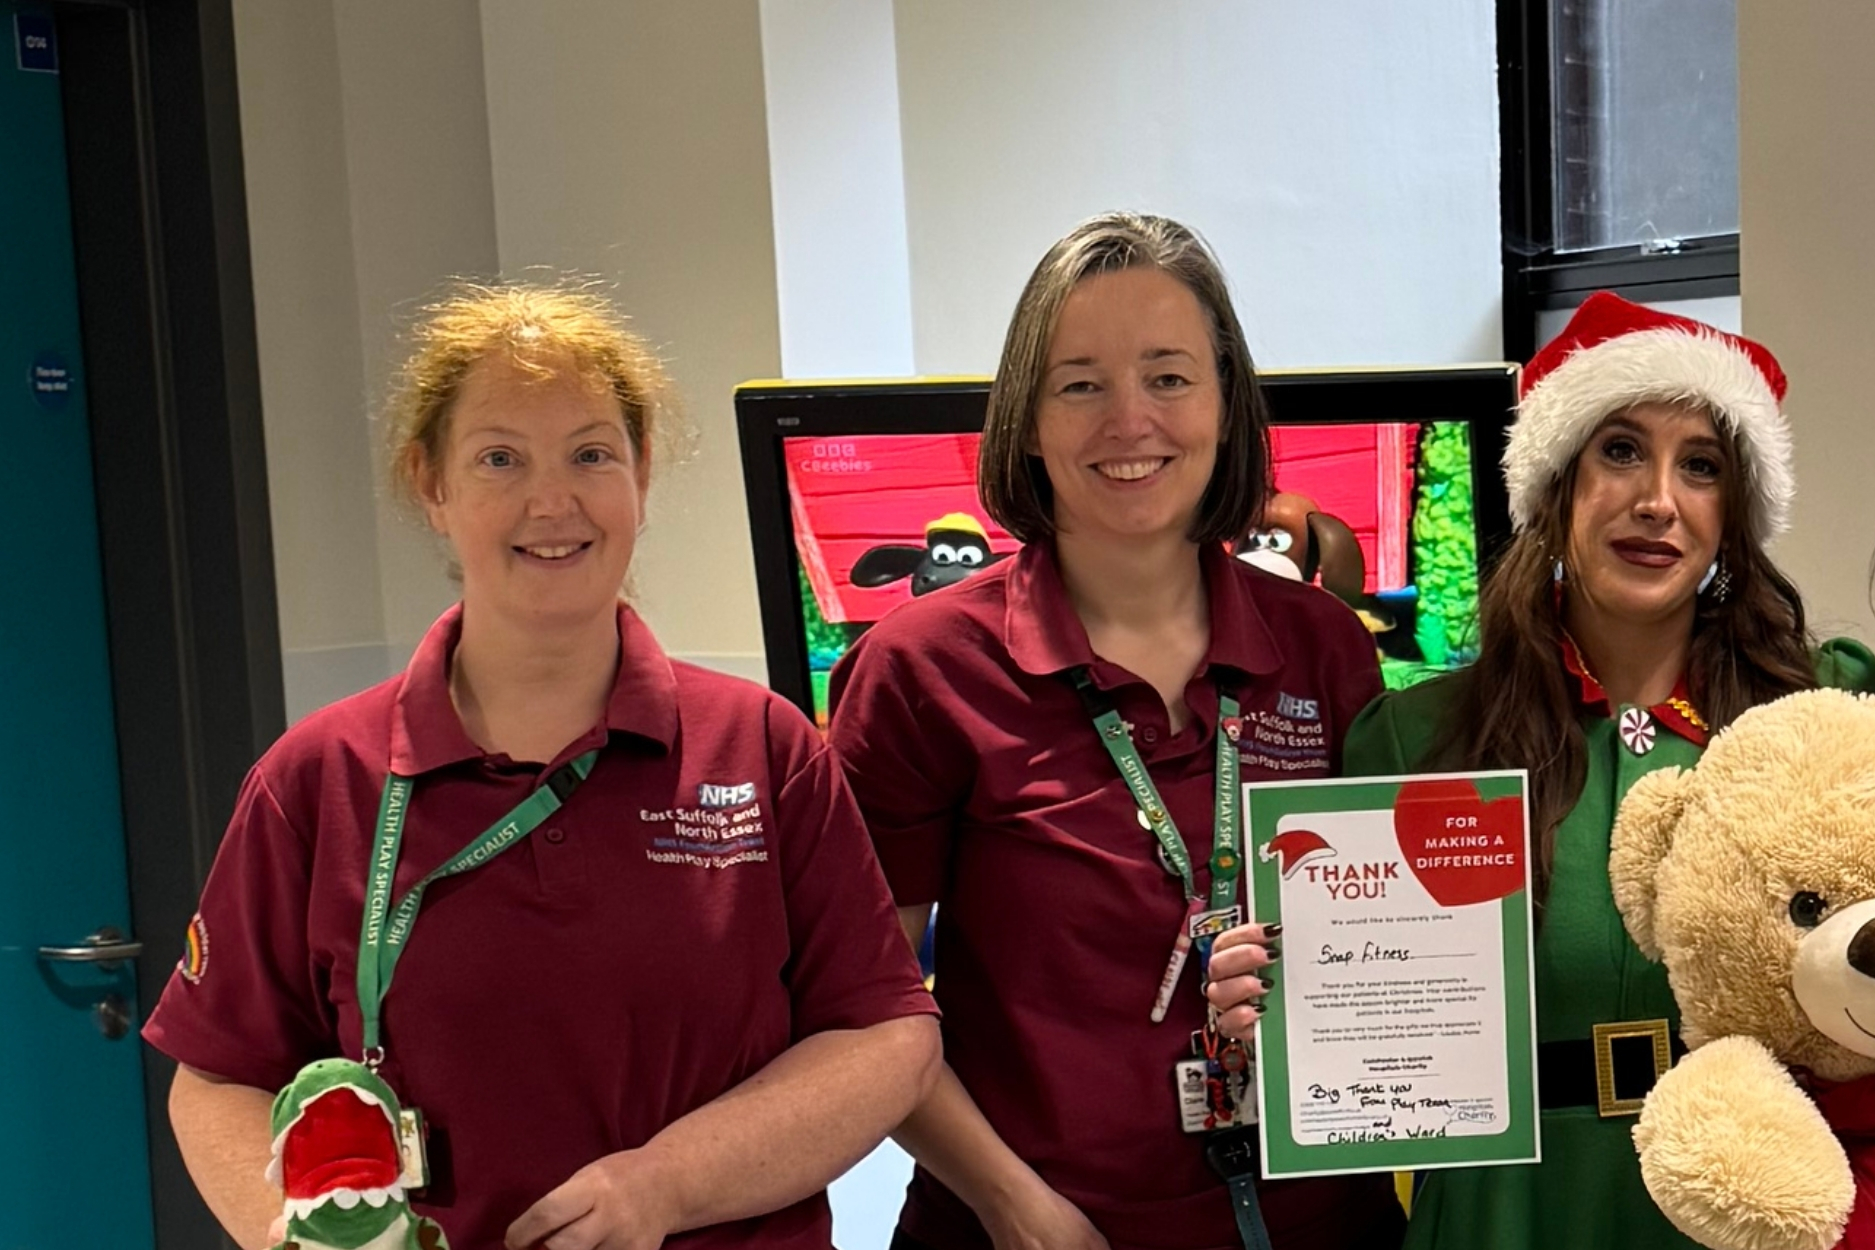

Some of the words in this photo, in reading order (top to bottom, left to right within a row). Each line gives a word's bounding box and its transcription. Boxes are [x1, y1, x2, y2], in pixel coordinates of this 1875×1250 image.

[813, 443, 856, 457] BBC
[801, 460, 872, 472] CBeebies
[1260, 711, 1295, 732] Suffolk
[1298, 723, 1323, 734] and
[1255, 725, 1286, 745] North
[1287, 735, 1325, 746] Essex
[1121, 755, 1157, 812] PECIALIST
[700, 783, 755, 806] NHS
[384, 782, 406, 832] HEALTH
[640, 809, 674, 821] East
[676, 808, 729, 826] Suffolk
[732, 803, 761, 823] and
[1220, 792, 1233, 822] PLAY
[674, 822, 718, 840] North
[720, 822, 763, 839] Essex
[1446, 817, 1478, 828] FOR
[450, 821, 521, 874] SPECIALIST
[1425, 835, 1488, 848] MAKING
[1493, 835, 1504, 845] A
[378, 837, 396, 870] PLAY
[646, 849, 684, 863] Health
[685, 853, 711, 868] Play
[712, 850, 769, 869] Specialist
[1416, 853, 1515, 869] DIFFERENCE
[1305, 862, 1399, 882] THANK
[1326, 881, 1386, 900] YOU!
[366, 872, 389, 946] SPECIALIST
[386, 892, 418, 945] HEALTH
[1308, 1083, 1341, 1104] Big
[1346, 1083, 1385, 1097] Thank
[1389, 1083, 1413, 1094] you
[1372, 1117, 1393, 1129] and
[1406, 1125, 1447, 1139] Ward
